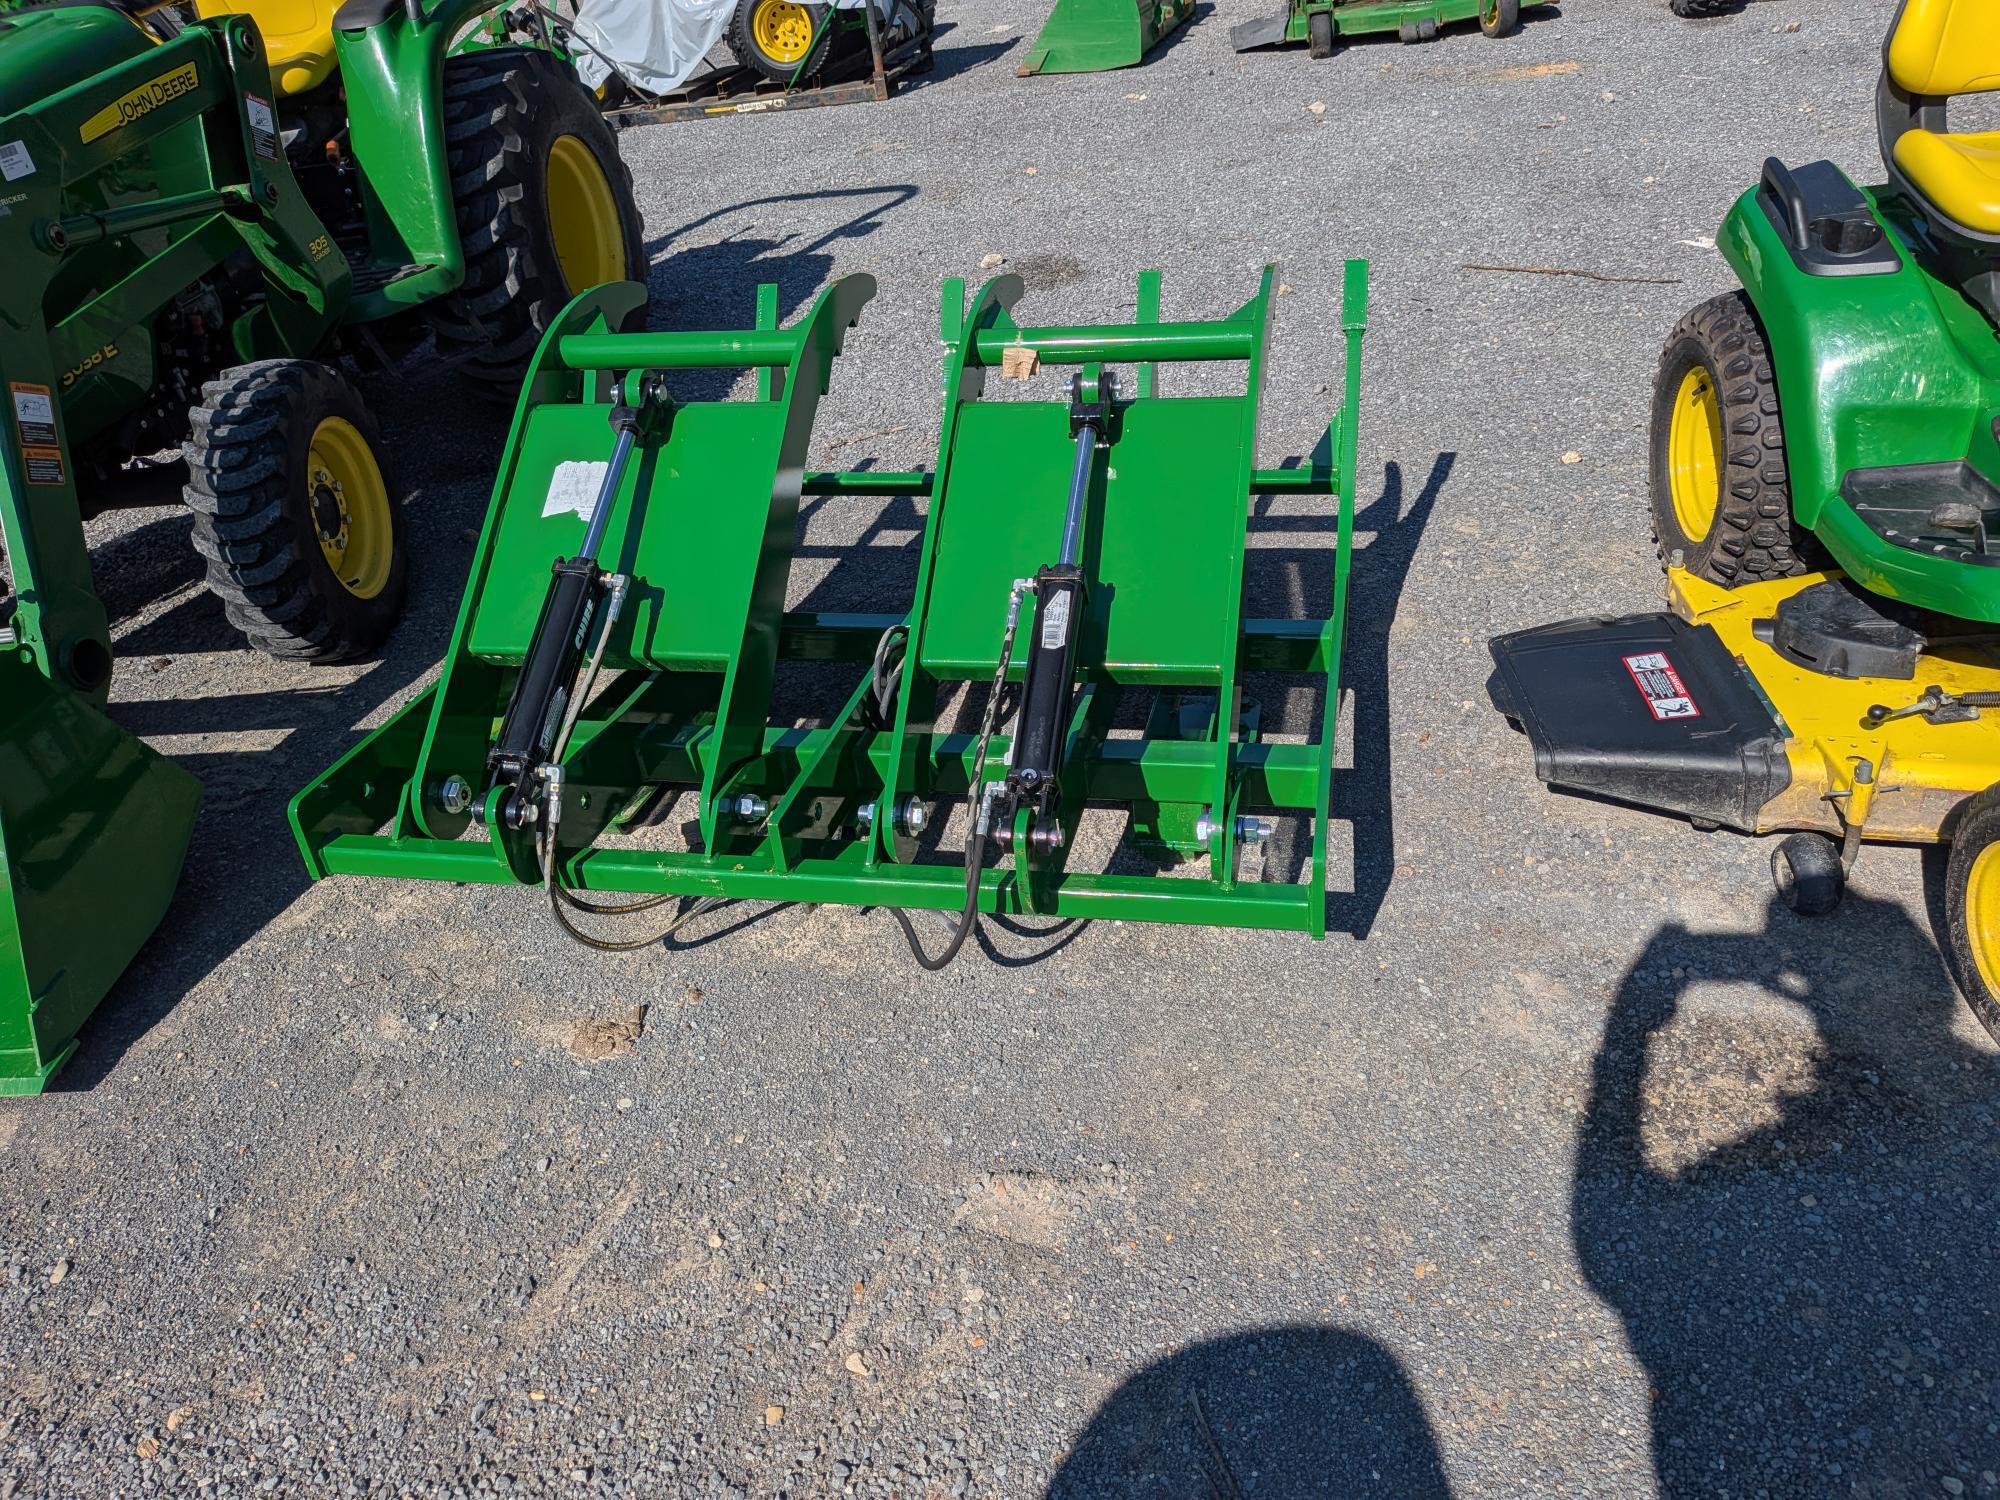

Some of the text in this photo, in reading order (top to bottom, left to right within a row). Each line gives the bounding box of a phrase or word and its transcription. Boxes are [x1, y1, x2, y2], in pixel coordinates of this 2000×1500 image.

[116, 71, 196, 123] JOHN DEERE
[309, 235, 327, 254] 305
